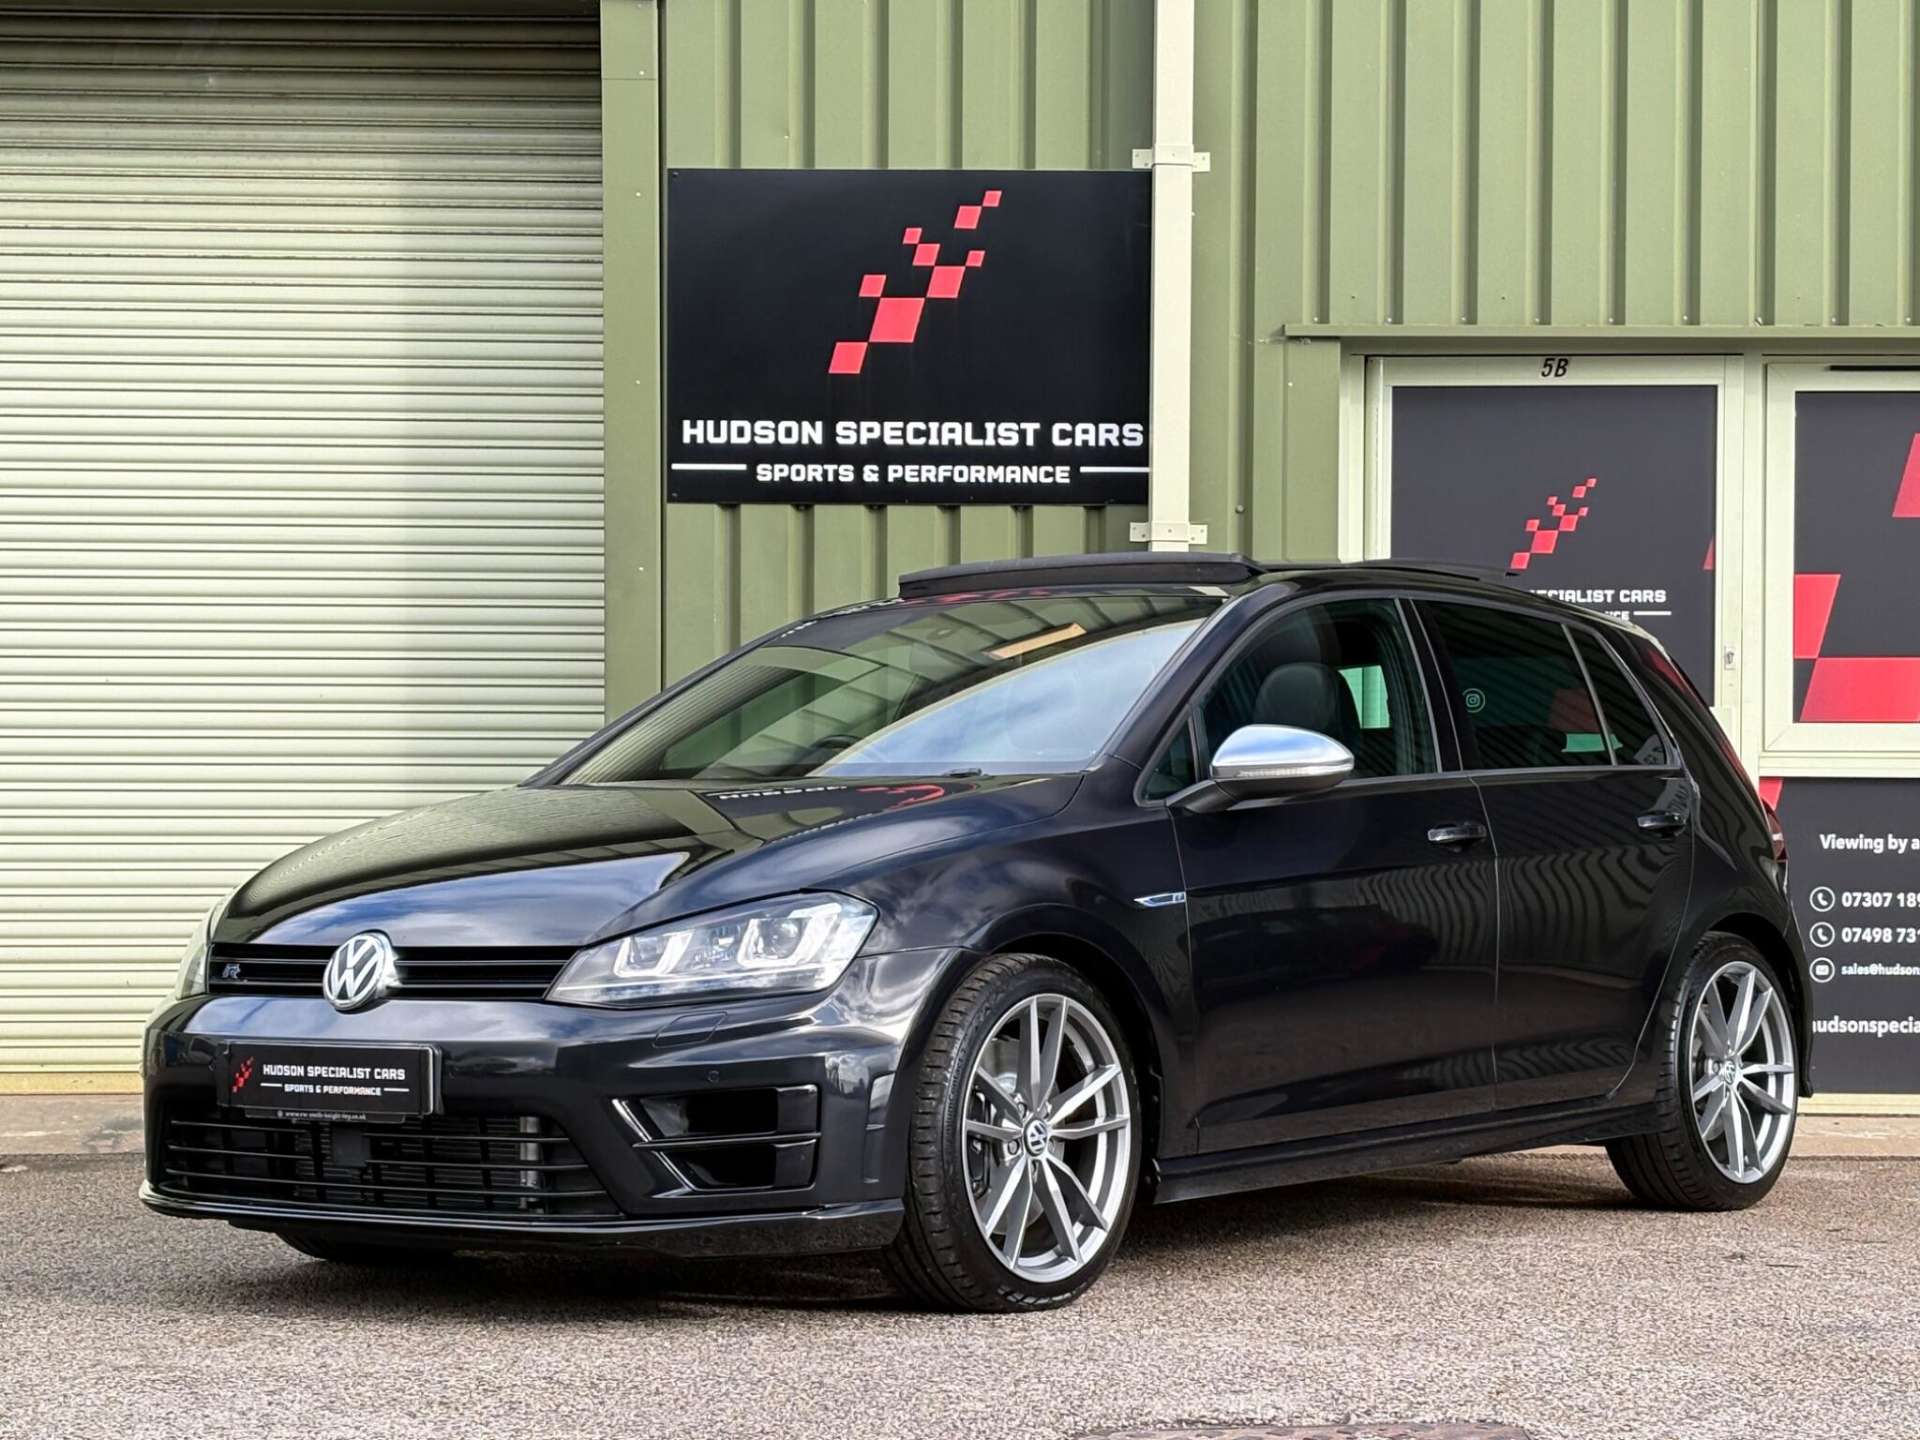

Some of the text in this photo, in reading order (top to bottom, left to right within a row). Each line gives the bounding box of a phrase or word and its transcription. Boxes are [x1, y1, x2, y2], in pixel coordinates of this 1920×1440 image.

[1541, 357, 1569, 377] 5B
[682, 419, 1144, 448] HUDSON SPECIALIST CARS
[756, 464, 1071, 484] SPORTS & PERFORMANCE
[1529, 589, 1667, 603] CIALIST CARS
[1819, 833, 1884, 854] Viewing
[1887, 833, 1909, 854] by
[1841, 891, 1893, 908] 07307
[1841, 927, 1893, 943] 07498
[1841, 962, 1920, 975] sales@hudson
[263, 1064, 405, 1080] HUDSON SPECIALIST CARS
[284, 1083, 314, 1093] SPORTS
[323, 1085, 381, 1096] PERFORMANCE
